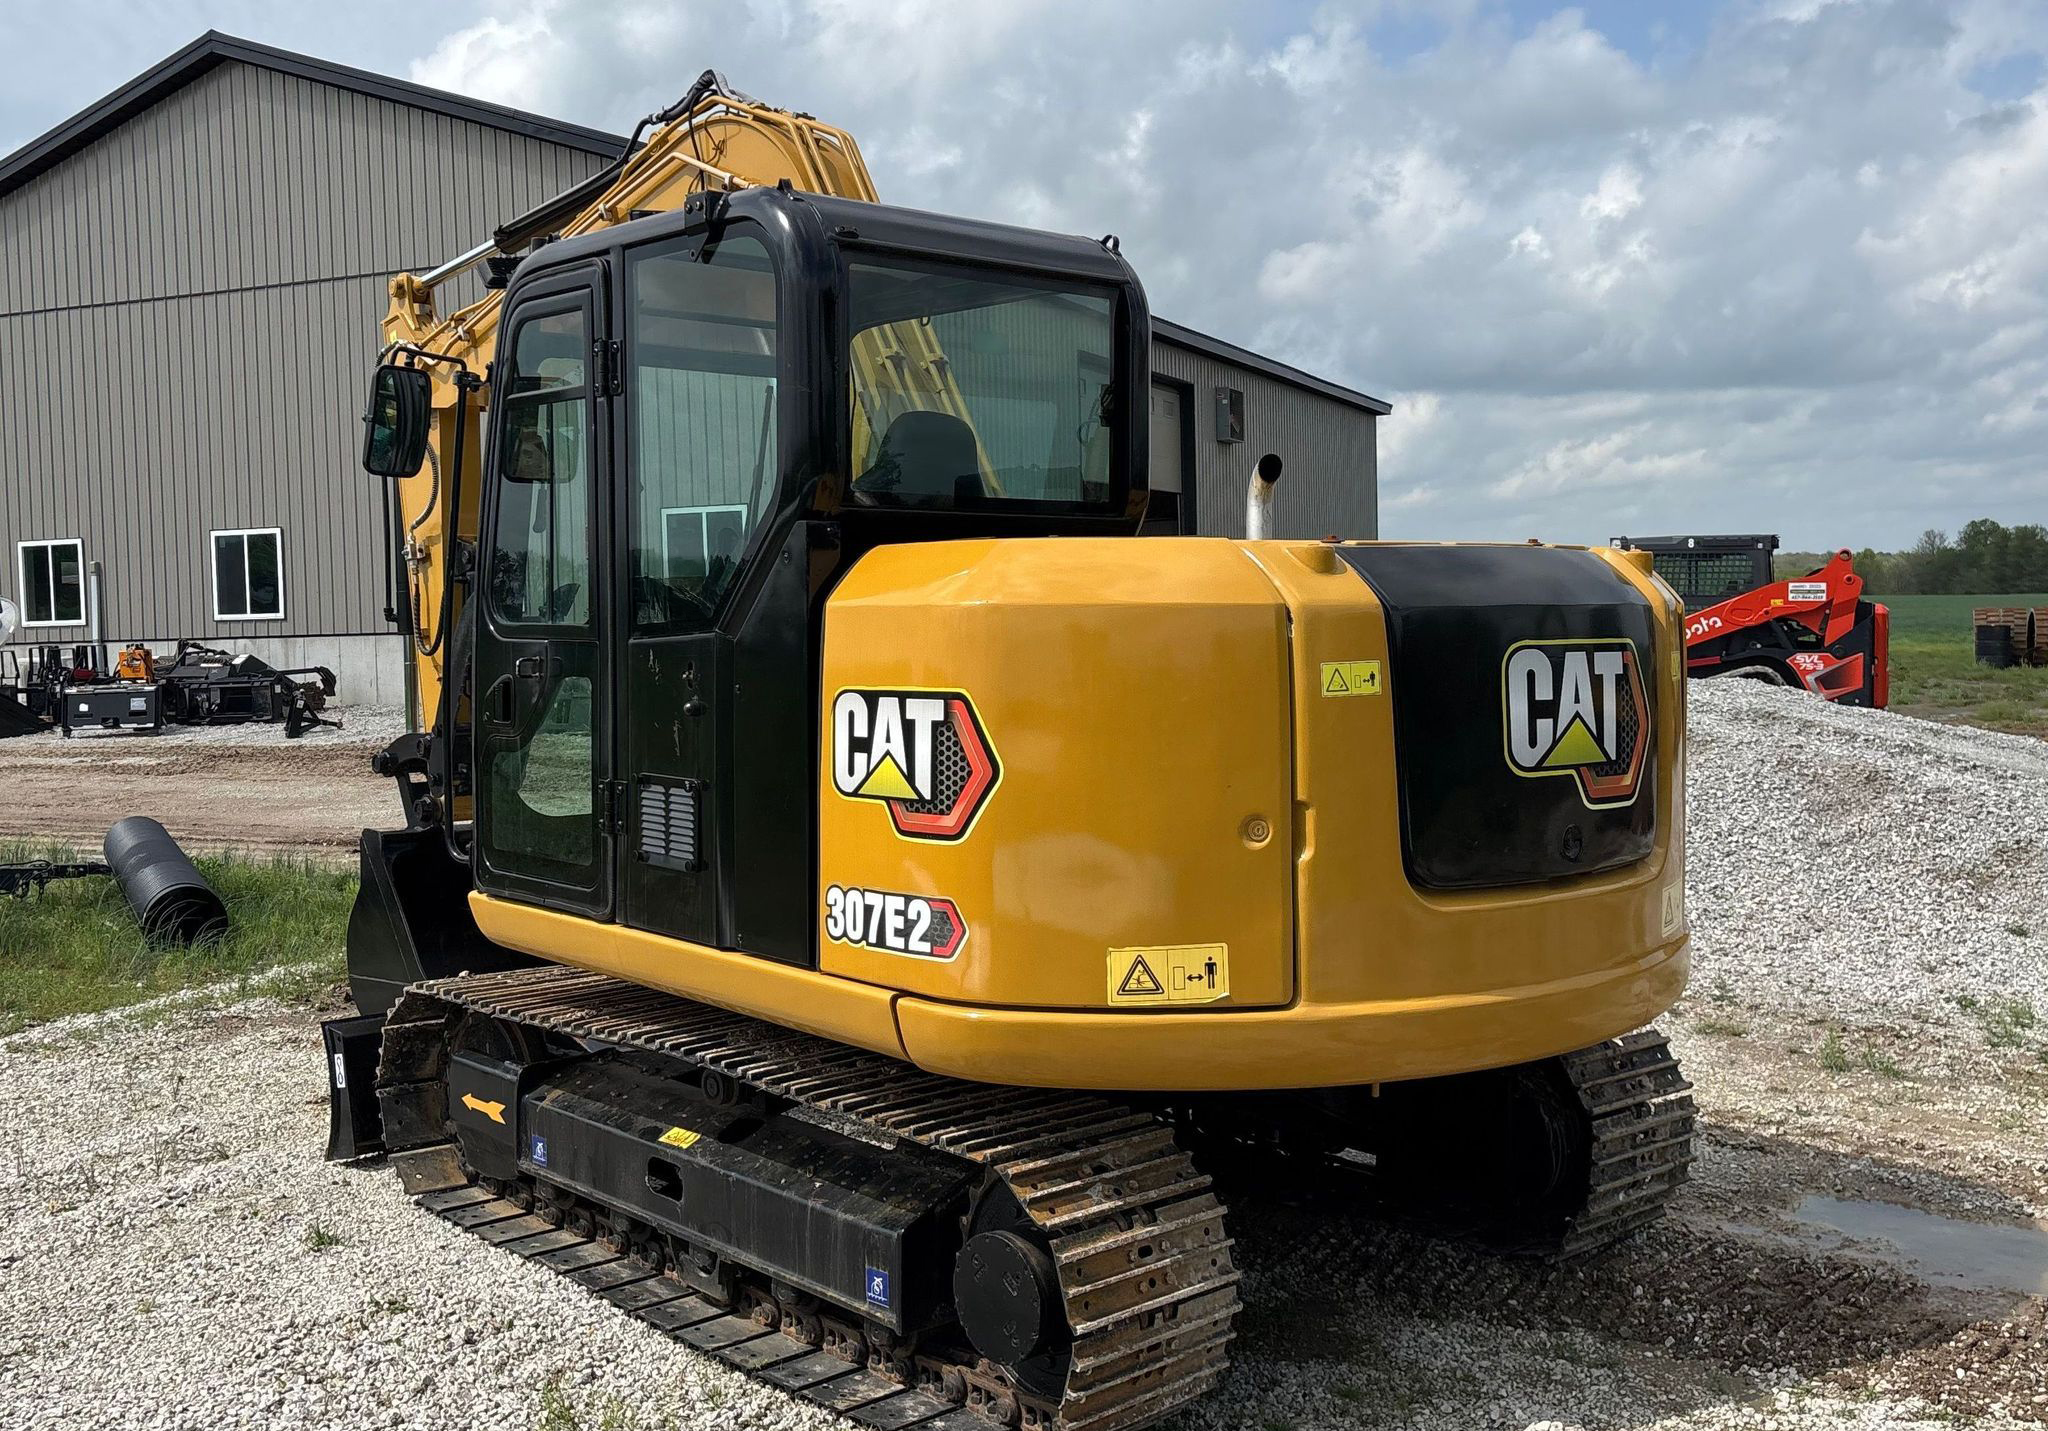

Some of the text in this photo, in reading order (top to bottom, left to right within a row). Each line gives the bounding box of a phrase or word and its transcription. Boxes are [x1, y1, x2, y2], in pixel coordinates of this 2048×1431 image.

[1688, 538, 1695, 548] 8
[1794, 655, 1824, 663] SVL
[1508, 649, 1624, 768] CAT
[835, 692, 945, 800] CAT
[826, 887, 932, 954] 307E2
